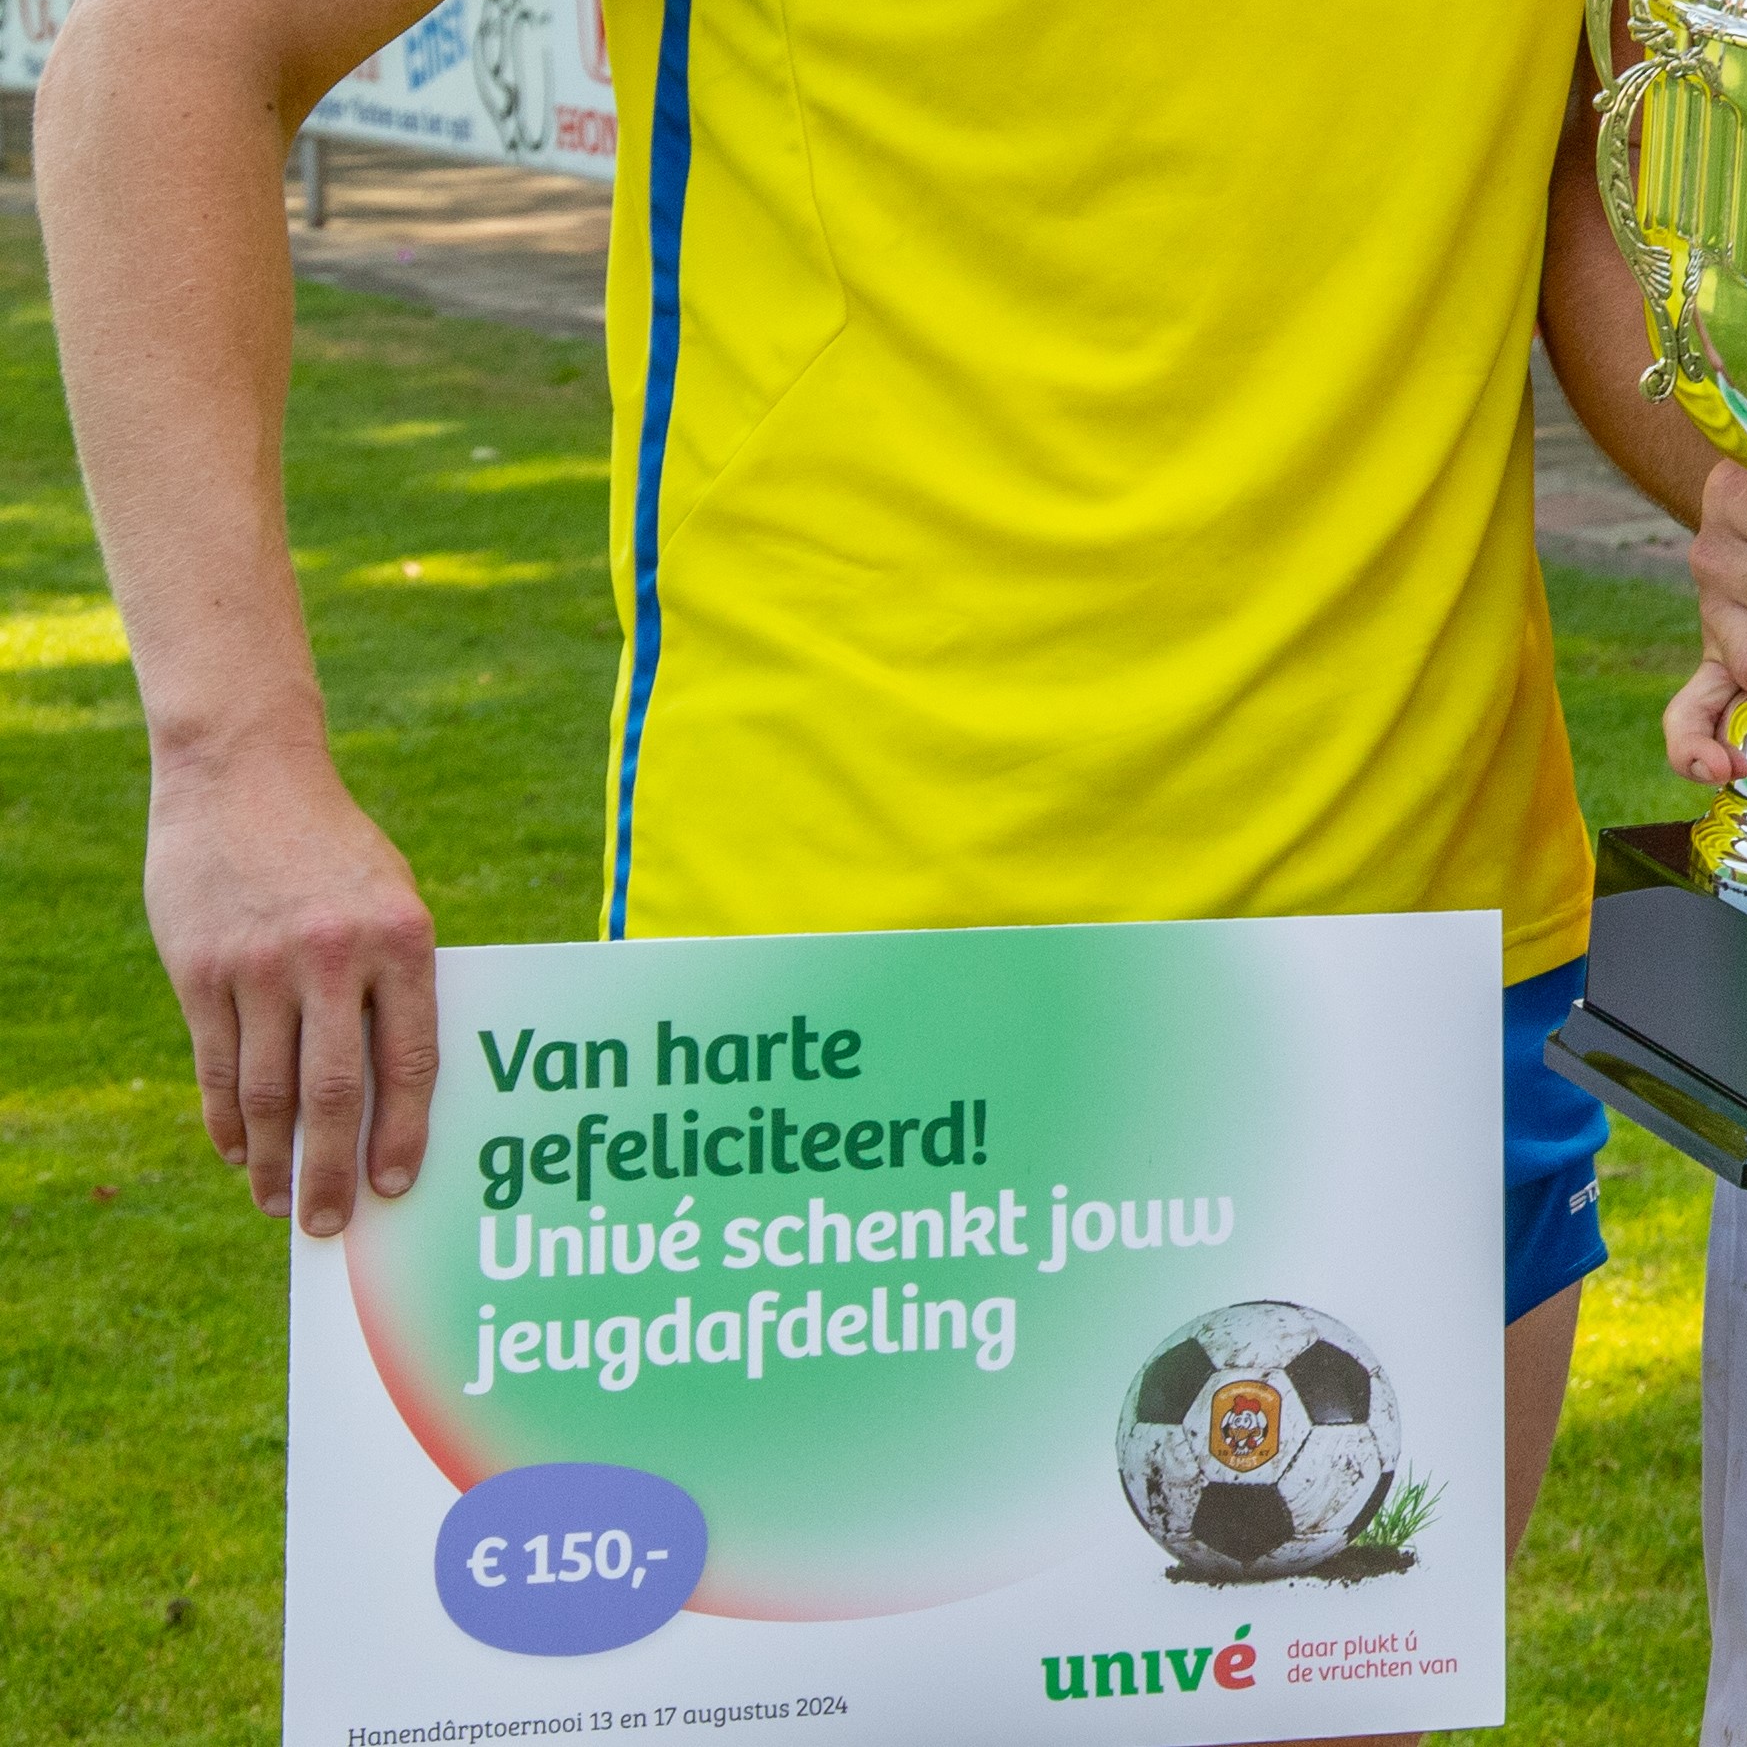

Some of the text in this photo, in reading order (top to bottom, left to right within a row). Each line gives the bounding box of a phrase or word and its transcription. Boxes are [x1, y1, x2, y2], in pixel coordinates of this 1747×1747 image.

[477, 1015, 862, 1092] Van harte
[478, 1100, 990, 1210] gefeliciteerd!
[478, 1184, 1233, 1281] Univé schenkt jouw
[463, 1283, 1017, 1395] jeugdafdeling
[466, 1528, 670, 1590] € 150,-
[1041, 1623, 1257, 1702] univé
[1287, 1637, 1338, 1660] daar
[1344, 1633, 1400, 1662] plukt
[1287, 1657, 1459, 1684] de vruchten van
[347, 1694, 850, 1747] Hanendârptoernooi 13 en 17 augustus 2024
